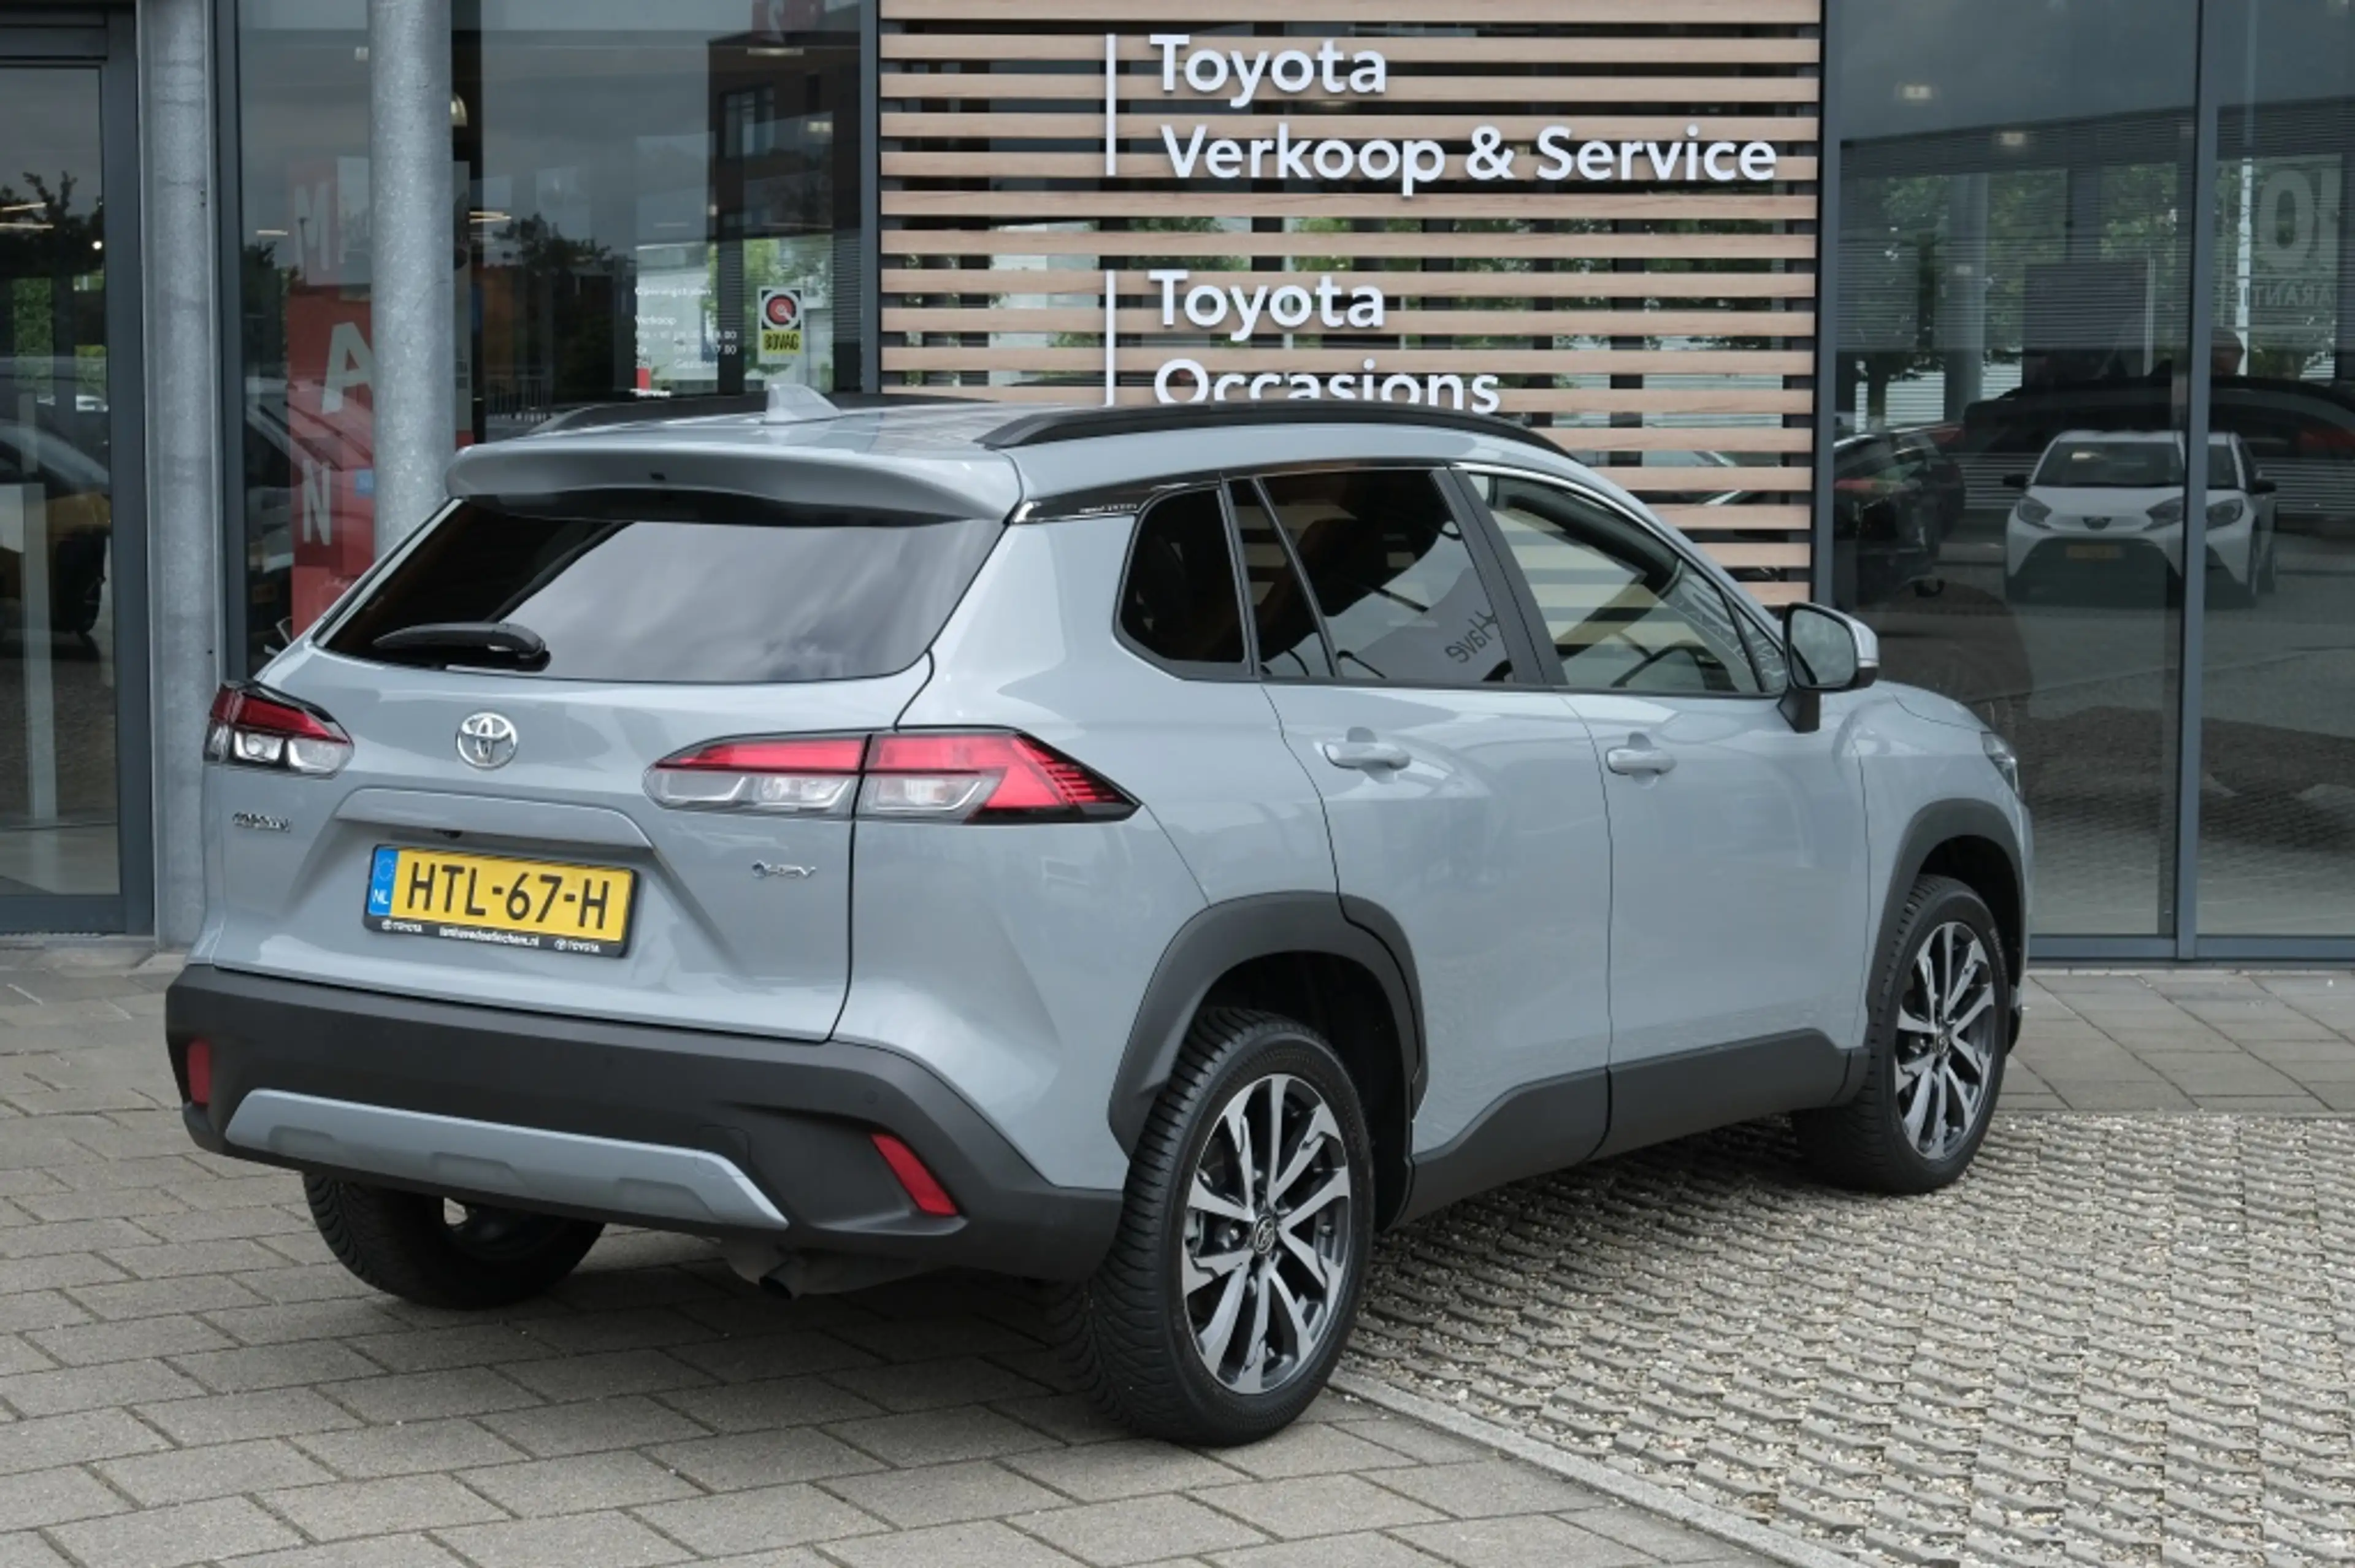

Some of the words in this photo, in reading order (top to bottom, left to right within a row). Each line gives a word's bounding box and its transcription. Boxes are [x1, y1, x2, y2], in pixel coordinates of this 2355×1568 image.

[1149, 34, 1387, 107] Toyota
[1161, 123, 1446, 197] Verkoop
[1465, 125, 1515, 180] &
[1536, 124, 1777, 181] Service
[1148, 270, 1384, 342] Toyota
[764, 333, 798, 350] BOVAG
[1154, 358, 1501, 414] Occasions
[371, 889, 389, 905] NL
[407, 862, 610, 930] HTL-67-H
